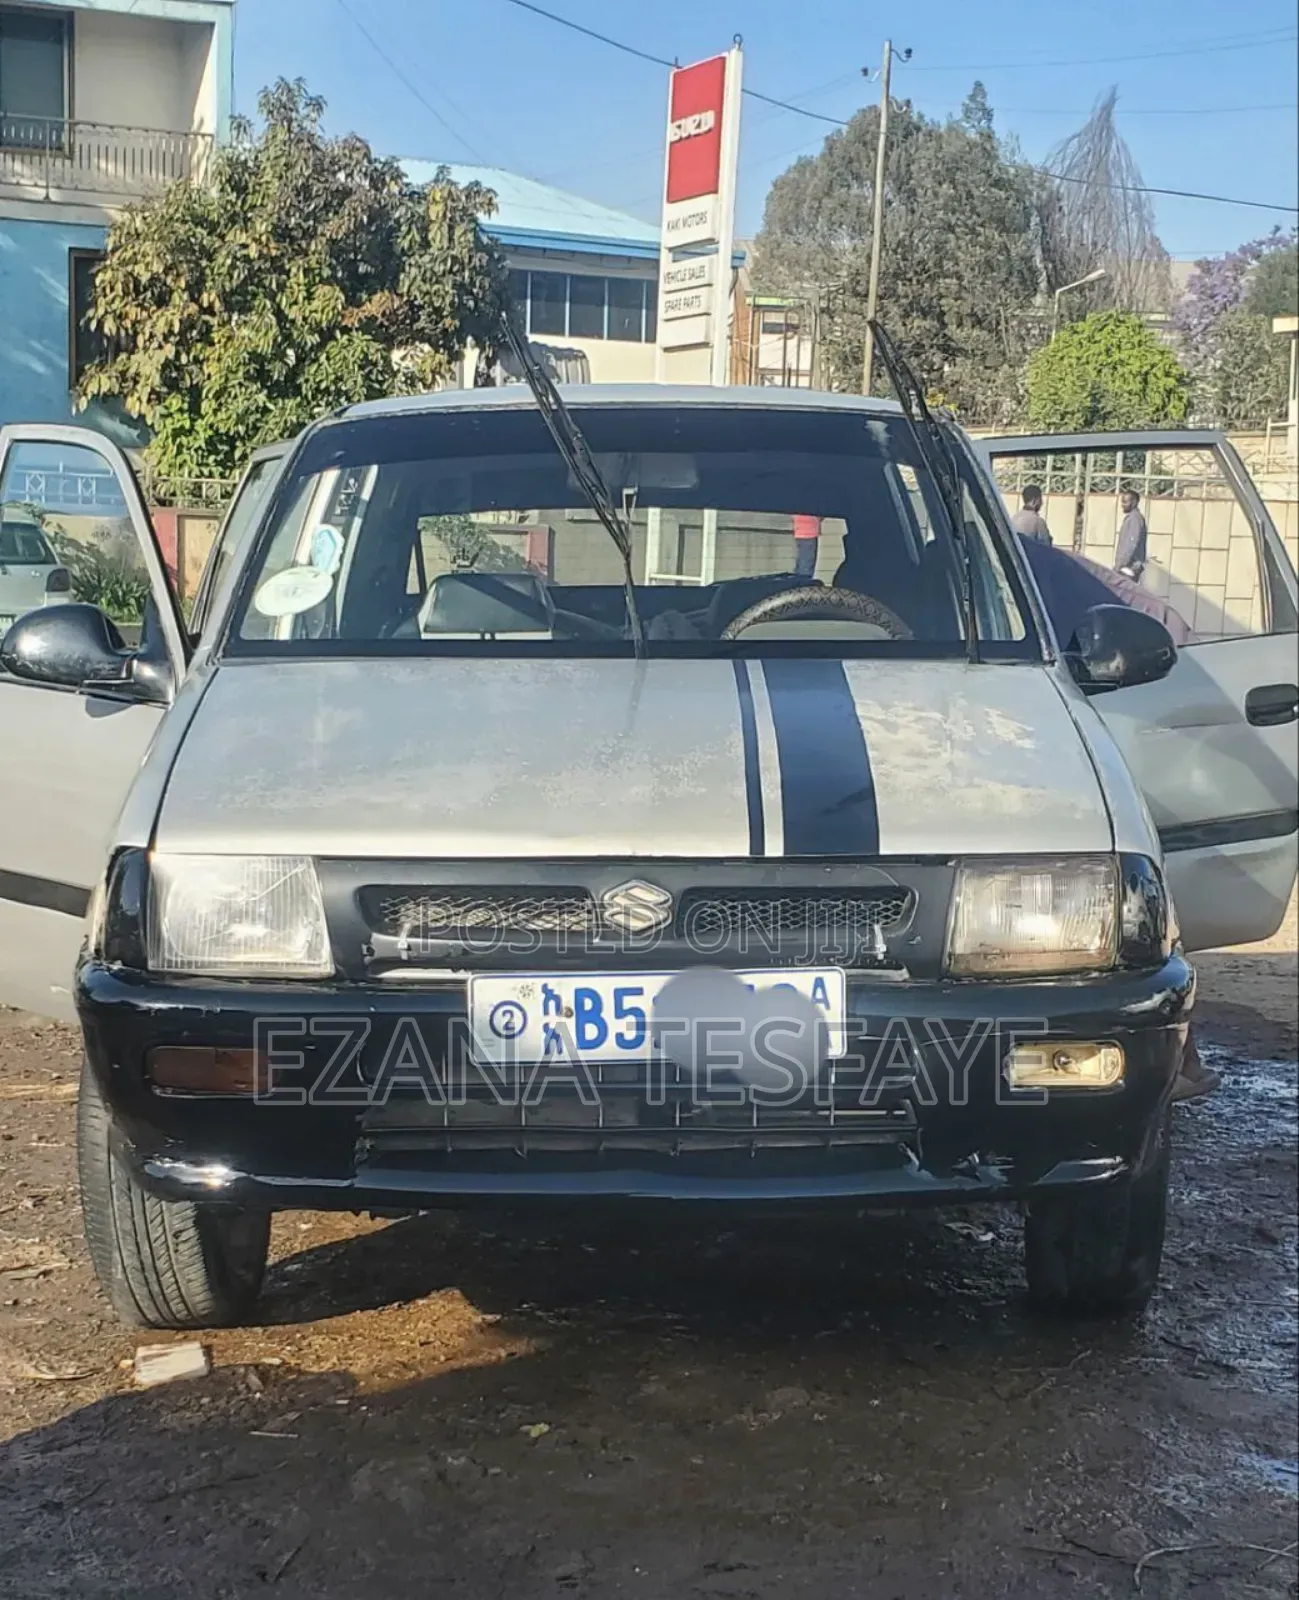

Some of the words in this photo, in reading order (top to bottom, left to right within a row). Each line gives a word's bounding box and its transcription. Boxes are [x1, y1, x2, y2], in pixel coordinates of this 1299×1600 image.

[683, 210, 708, 229] MOTORS
[664, 267, 687, 284] VEHICLE
[688, 264, 706, 280] SALES
[664, 297, 682, 314] SPARE
[683, 294, 702, 310] PARTS
